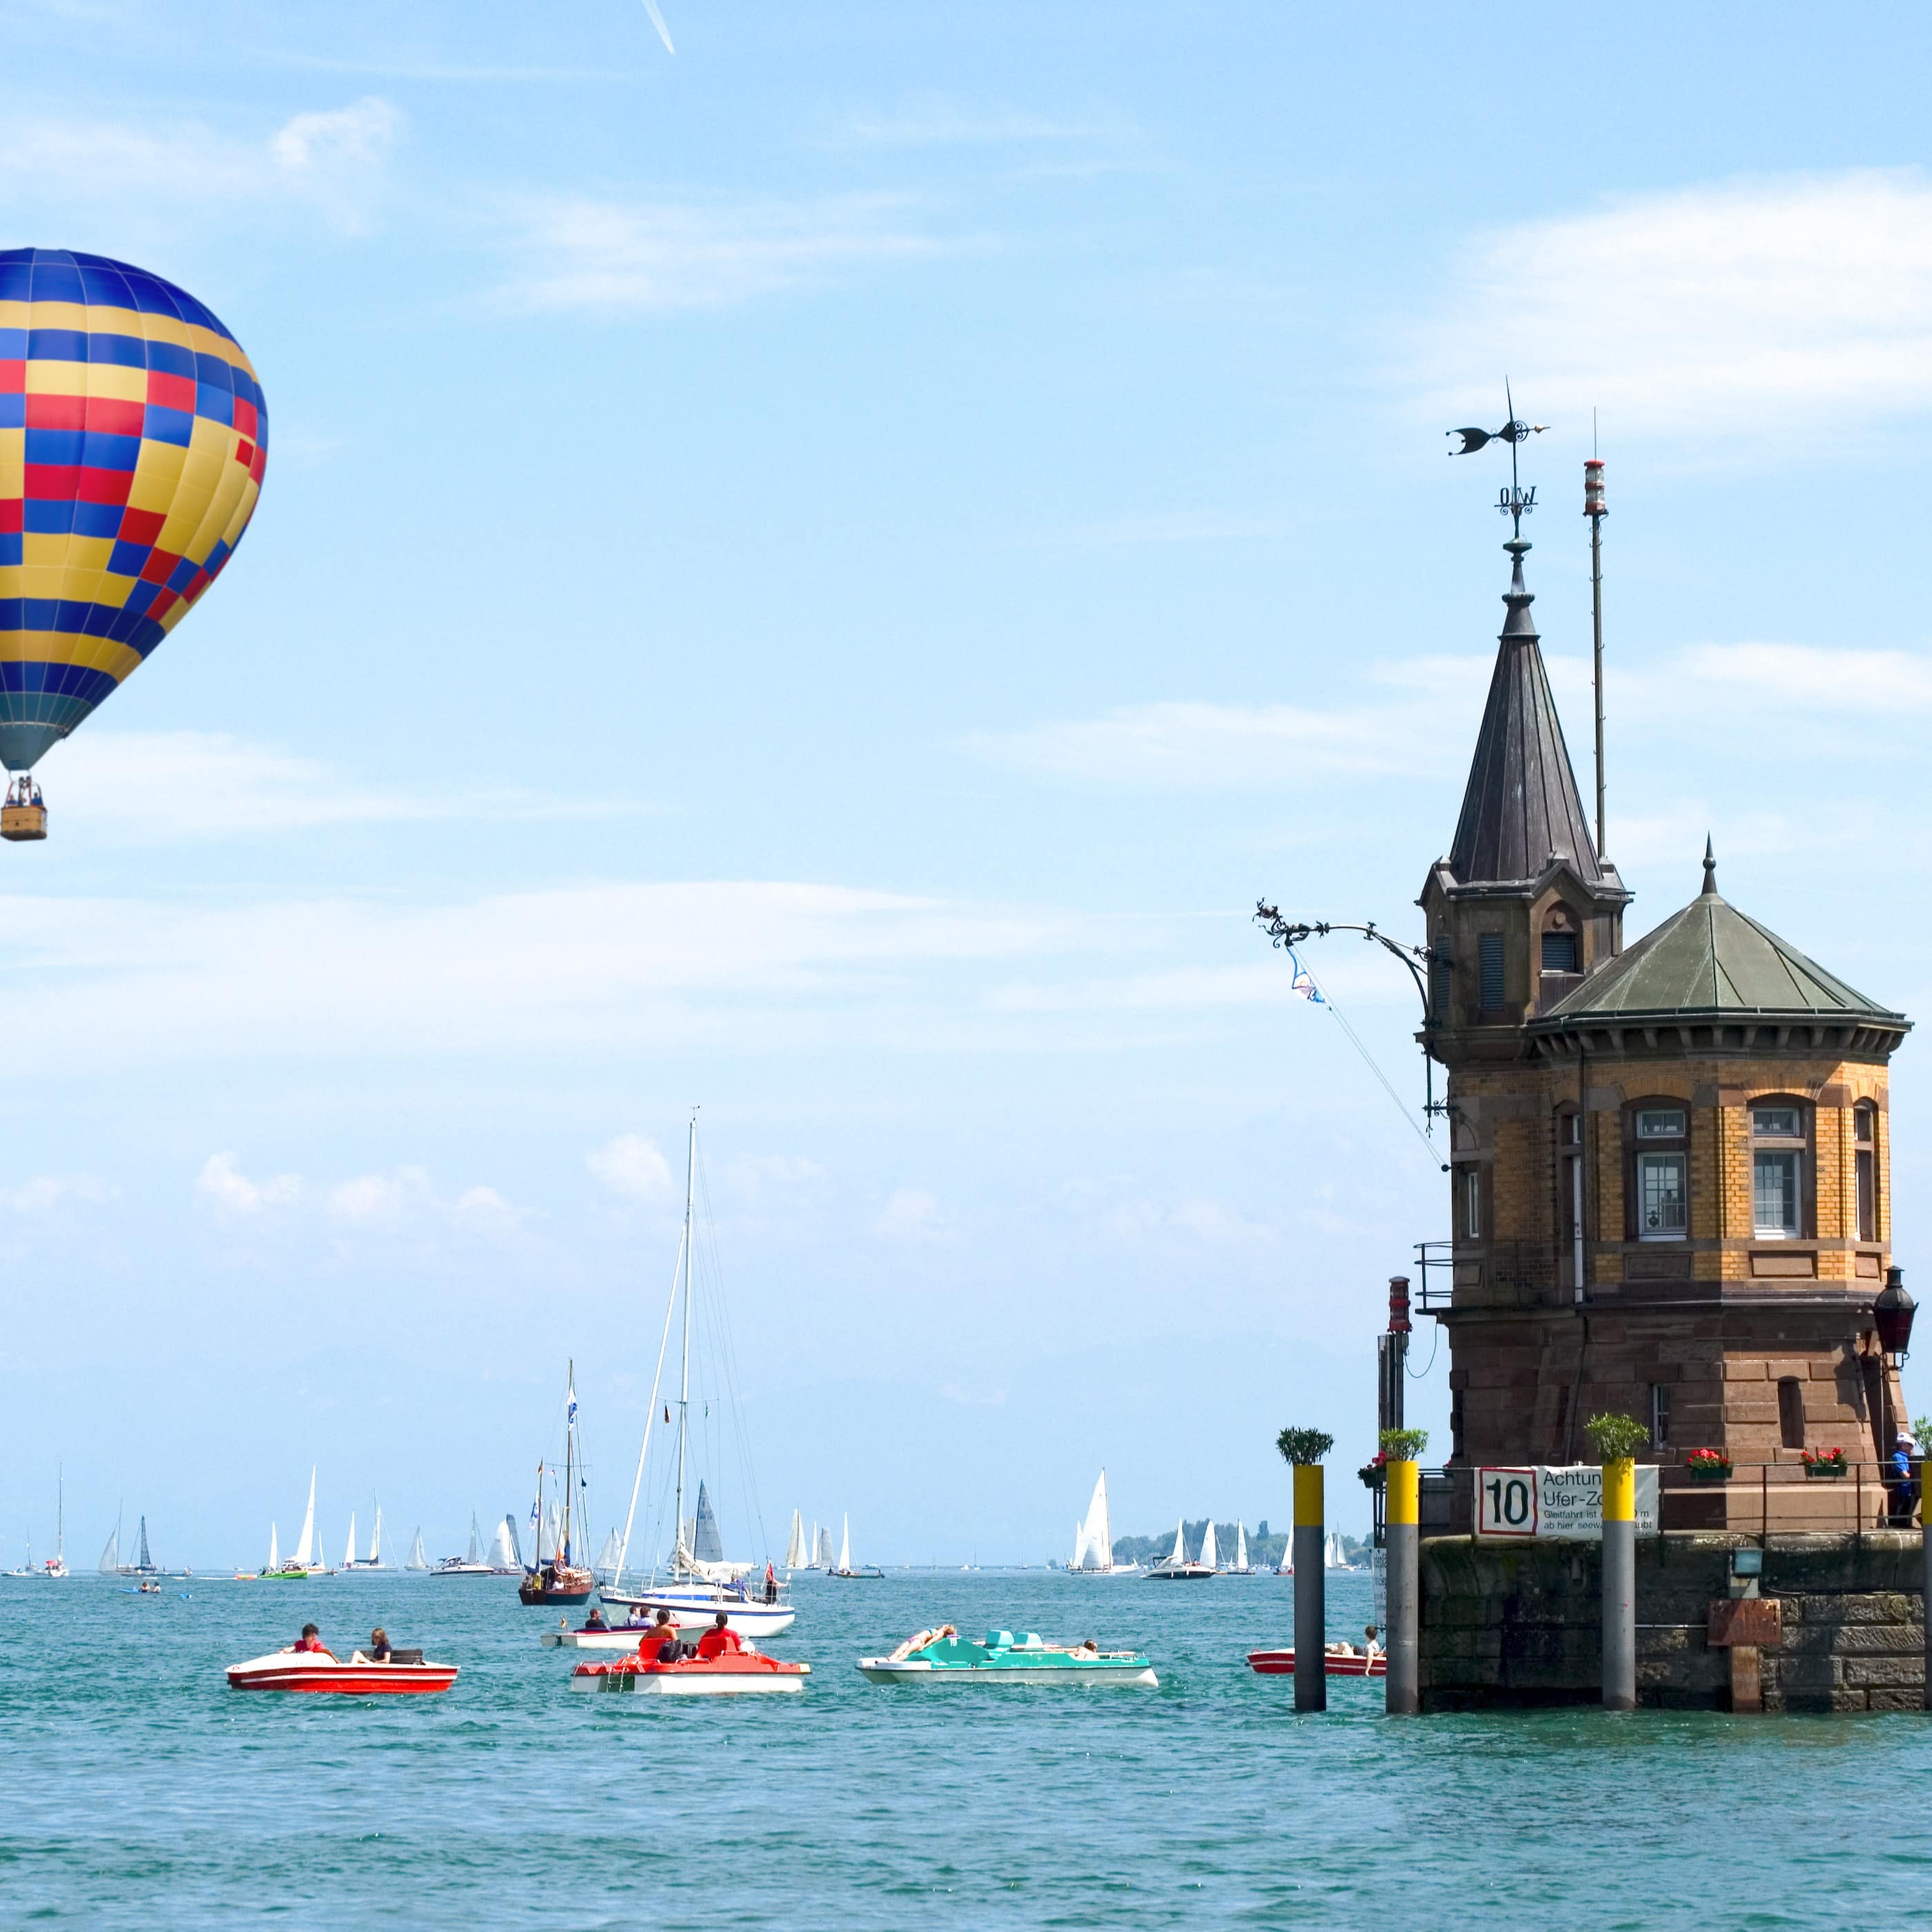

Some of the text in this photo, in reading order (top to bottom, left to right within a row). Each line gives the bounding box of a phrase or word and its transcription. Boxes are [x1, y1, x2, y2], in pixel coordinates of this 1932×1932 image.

[1517, 486, 1537, 505] W
[1543, 1471, 1602, 1486] Achtun
[1486, 1478, 1528, 1525] 10
[1544, 1491, 1603, 1506] Ufer-Zo
[1544, 1510, 1584, 1518] Gleitfahrt
[1586, 1510, 1597, 1518] ist
[1544, 1521, 1555, 1529] ab
[1557, 1521, 1574, 1529] hier
